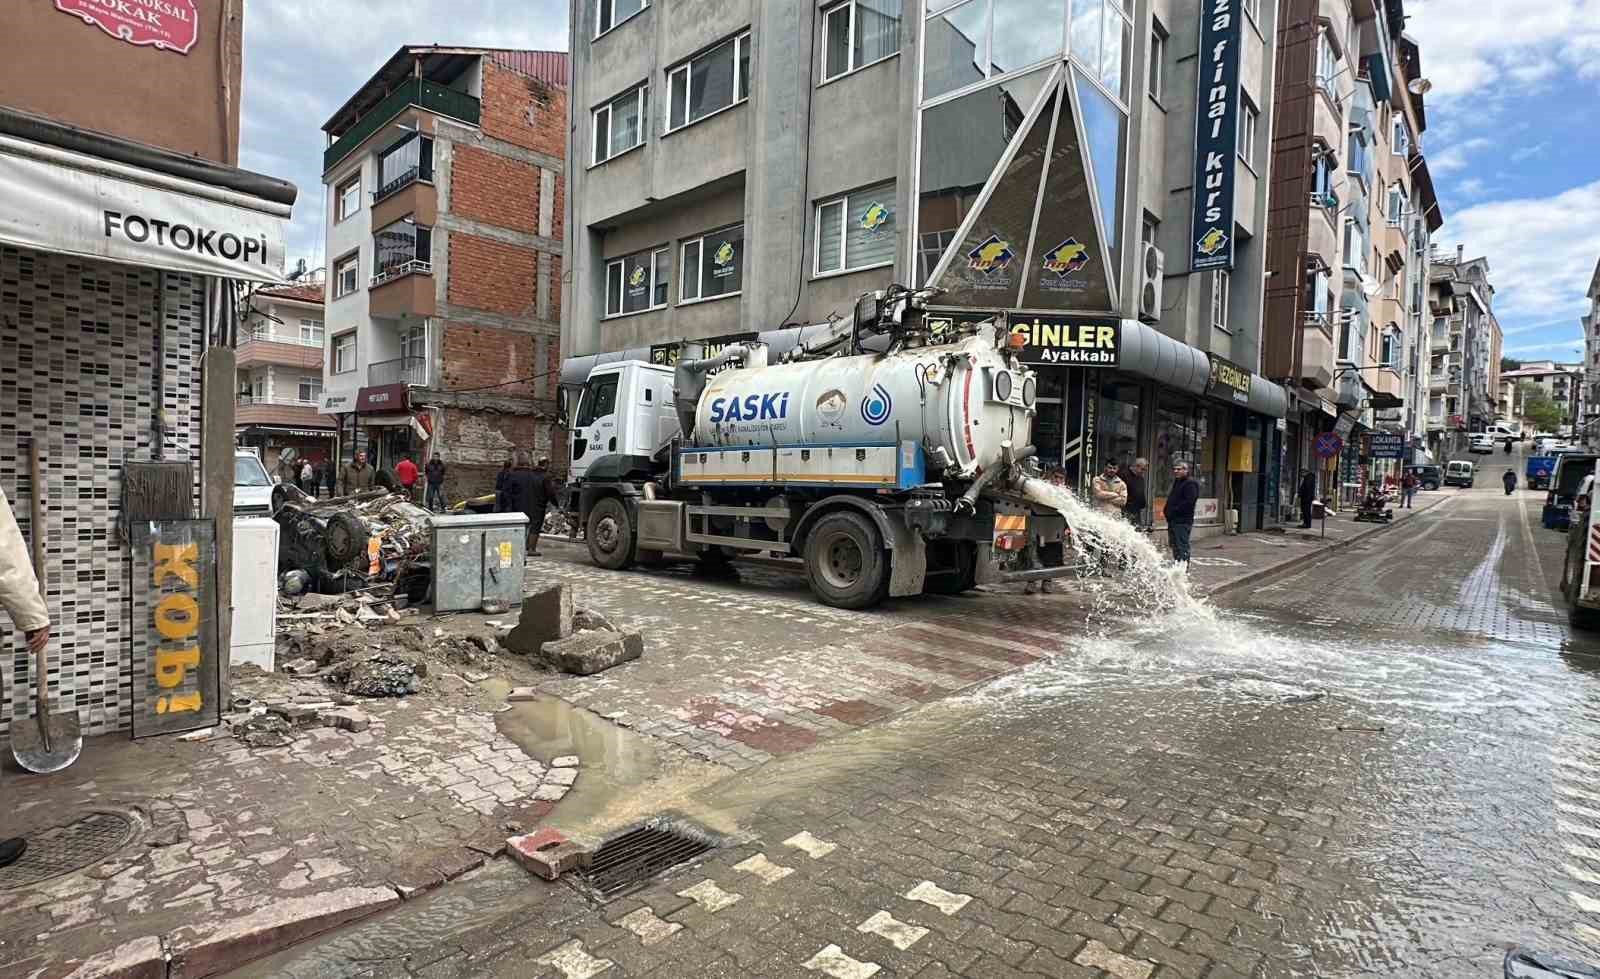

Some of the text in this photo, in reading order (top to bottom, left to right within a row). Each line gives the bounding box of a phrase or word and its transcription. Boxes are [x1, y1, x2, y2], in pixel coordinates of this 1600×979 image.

[94, 0, 162, 26] OKAK
[1205, 0, 1231, 222] za final kurs
[103, 209, 268, 265] FOTOKOPİ
[1011, 319, 1115, 349] GİNLER
[1040, 349, 1115, 363] Ayakkabı
